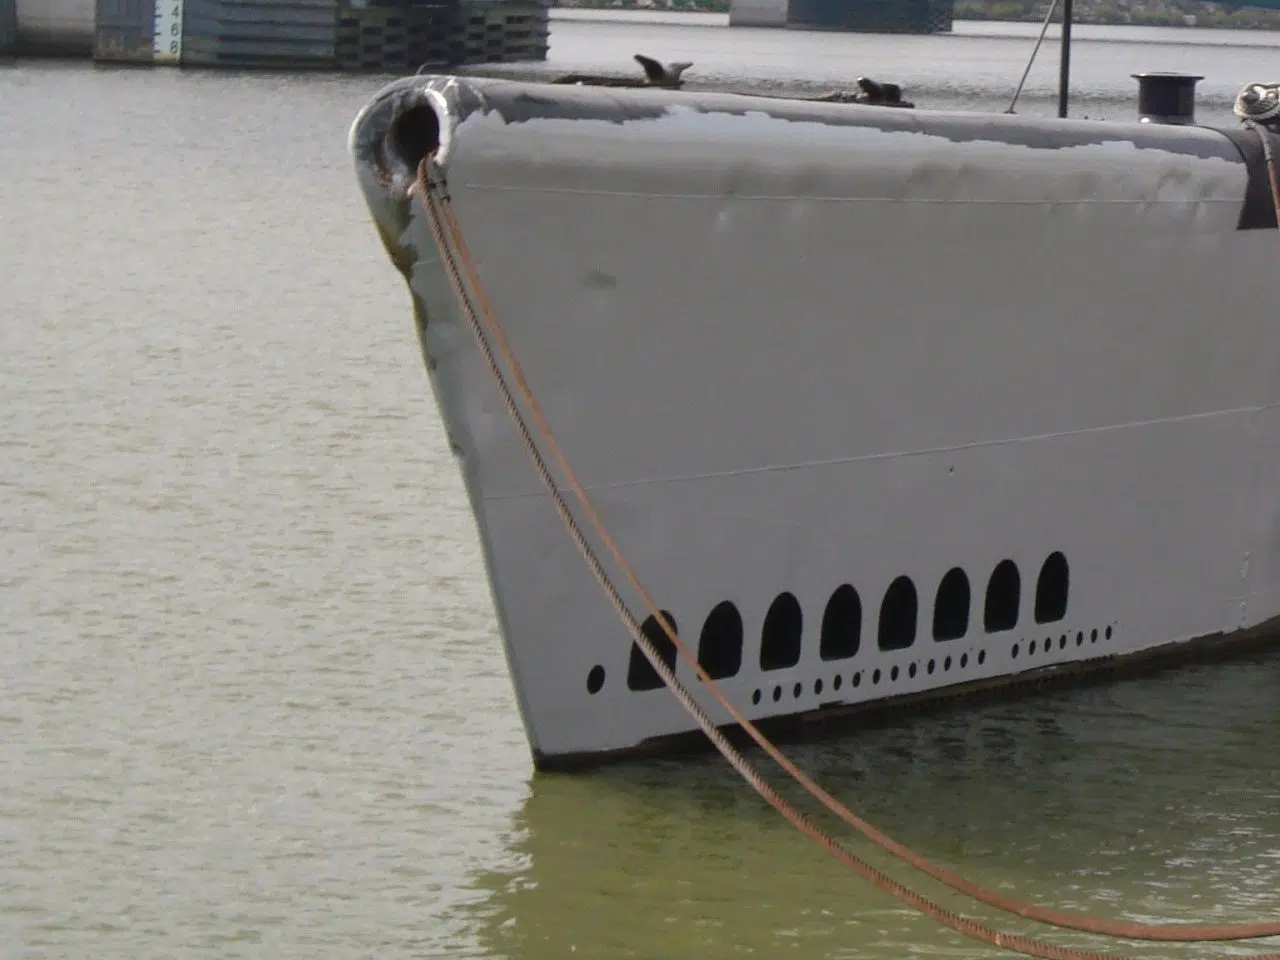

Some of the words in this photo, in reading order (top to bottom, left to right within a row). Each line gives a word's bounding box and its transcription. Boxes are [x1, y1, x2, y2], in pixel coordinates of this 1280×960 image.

[171, 5, 179, 17] 4
[170, 23, 179, 36] 6
[169, 40, 178, 53] 8
